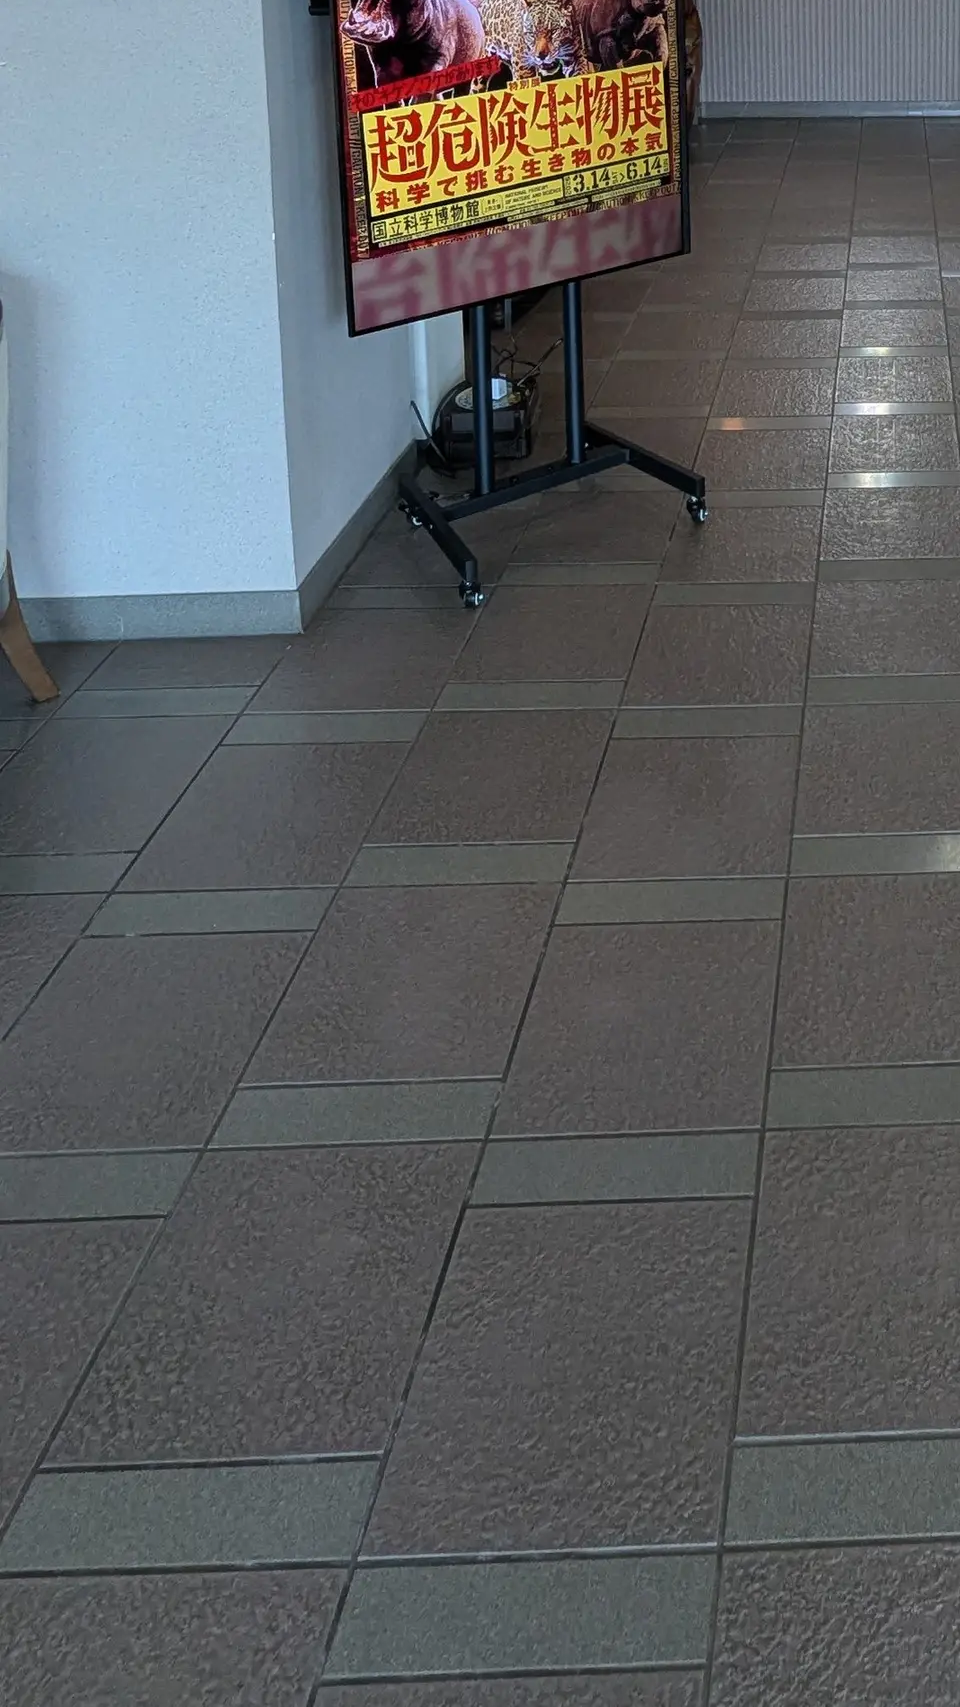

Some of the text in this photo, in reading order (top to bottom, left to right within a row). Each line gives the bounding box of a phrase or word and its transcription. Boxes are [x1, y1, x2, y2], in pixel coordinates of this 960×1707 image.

[368, 63, 666, 194] 超危険生物展
[375, 131, 664, 214] 科学で挑む生き物の本気
[626, 155, 662, 181] 6.14
[372, 200, 480, 241] 国立科学博物館
